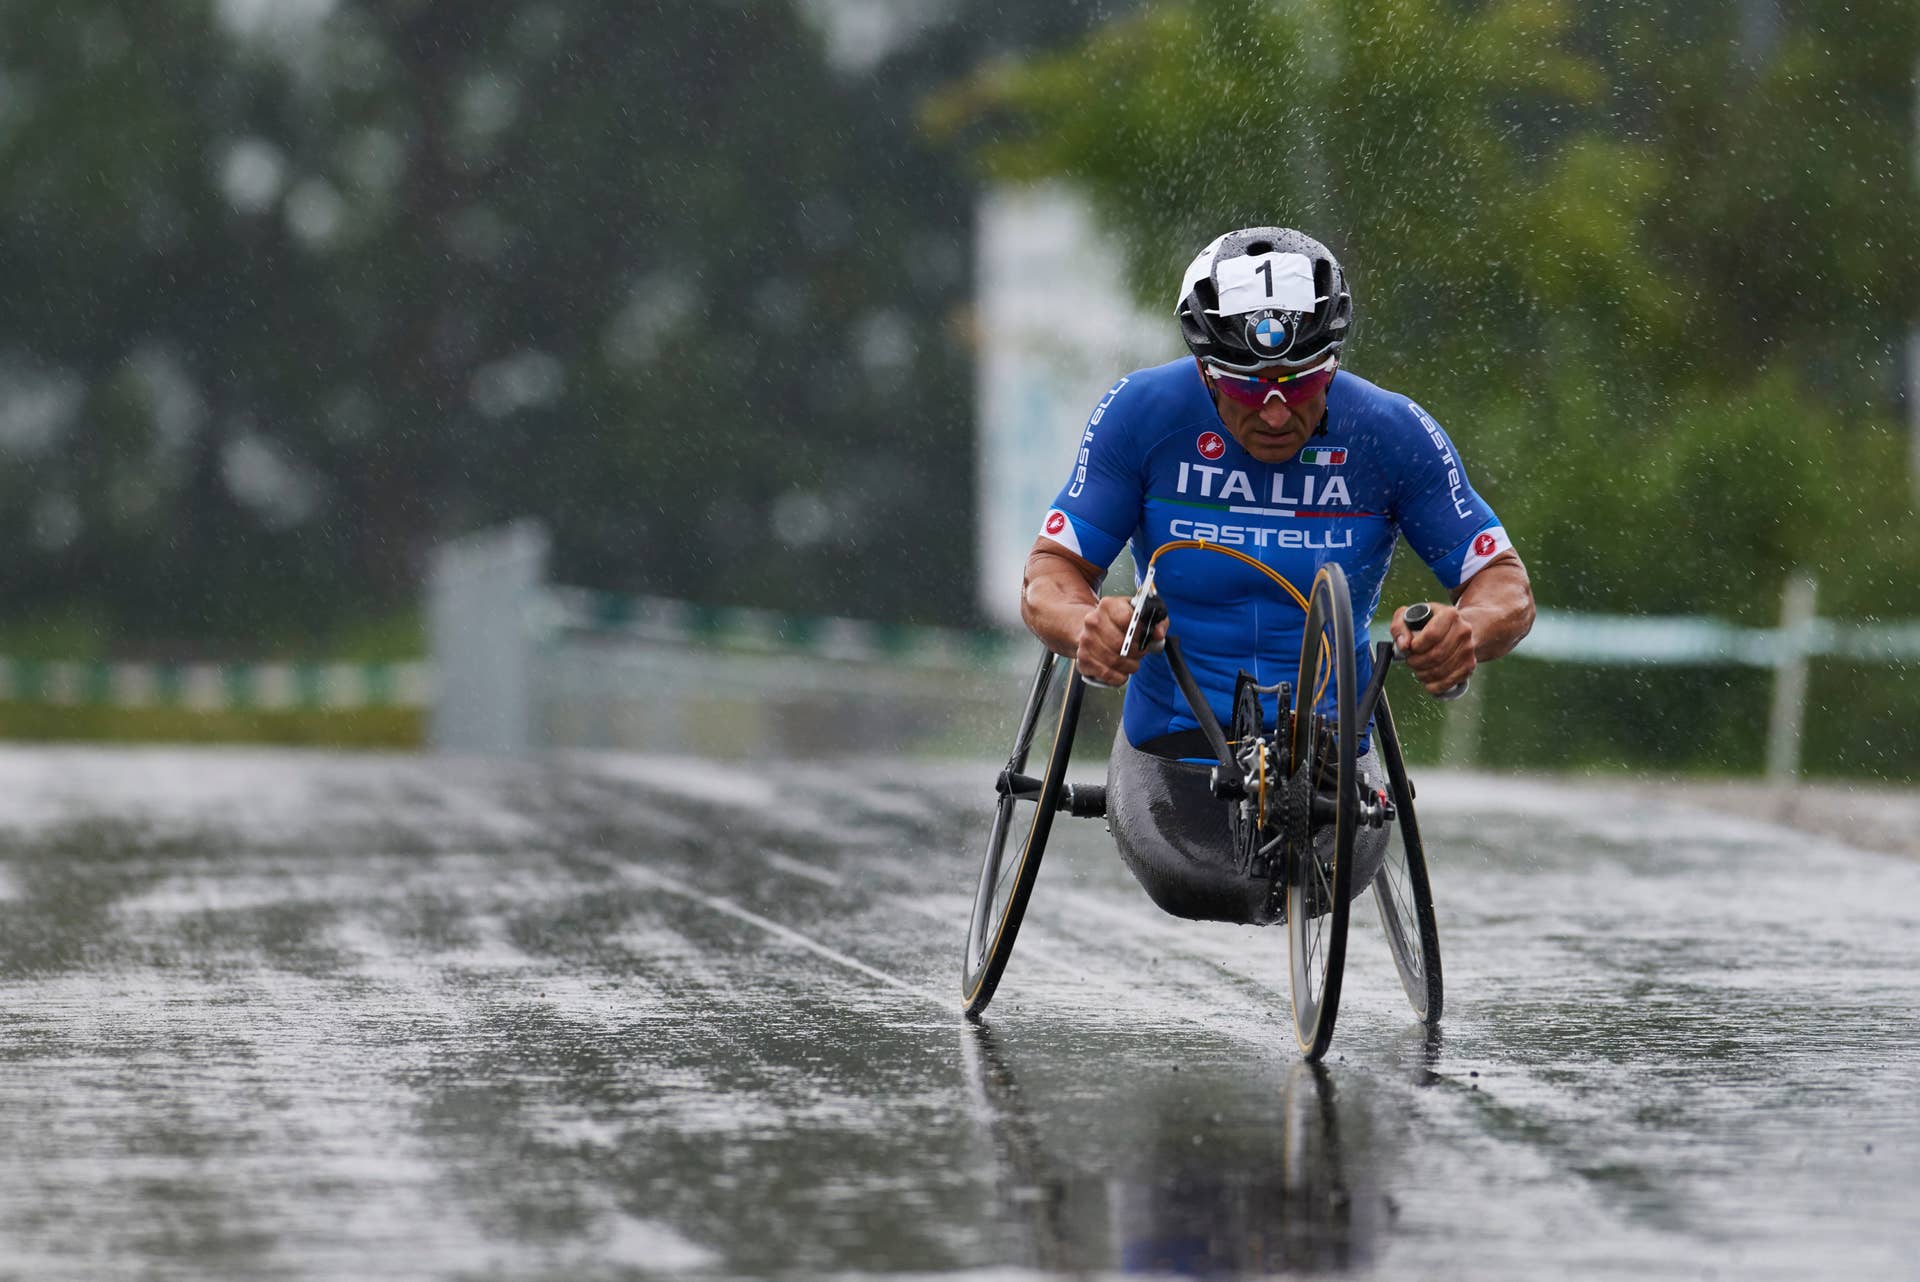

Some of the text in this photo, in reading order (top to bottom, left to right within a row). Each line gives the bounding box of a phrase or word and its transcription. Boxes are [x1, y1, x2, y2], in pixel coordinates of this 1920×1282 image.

[1255, 259, 1274, 298] 1
[1250, 309, 1289, 327] BMW
[1176, 461, 1352, 506] ITALIA
